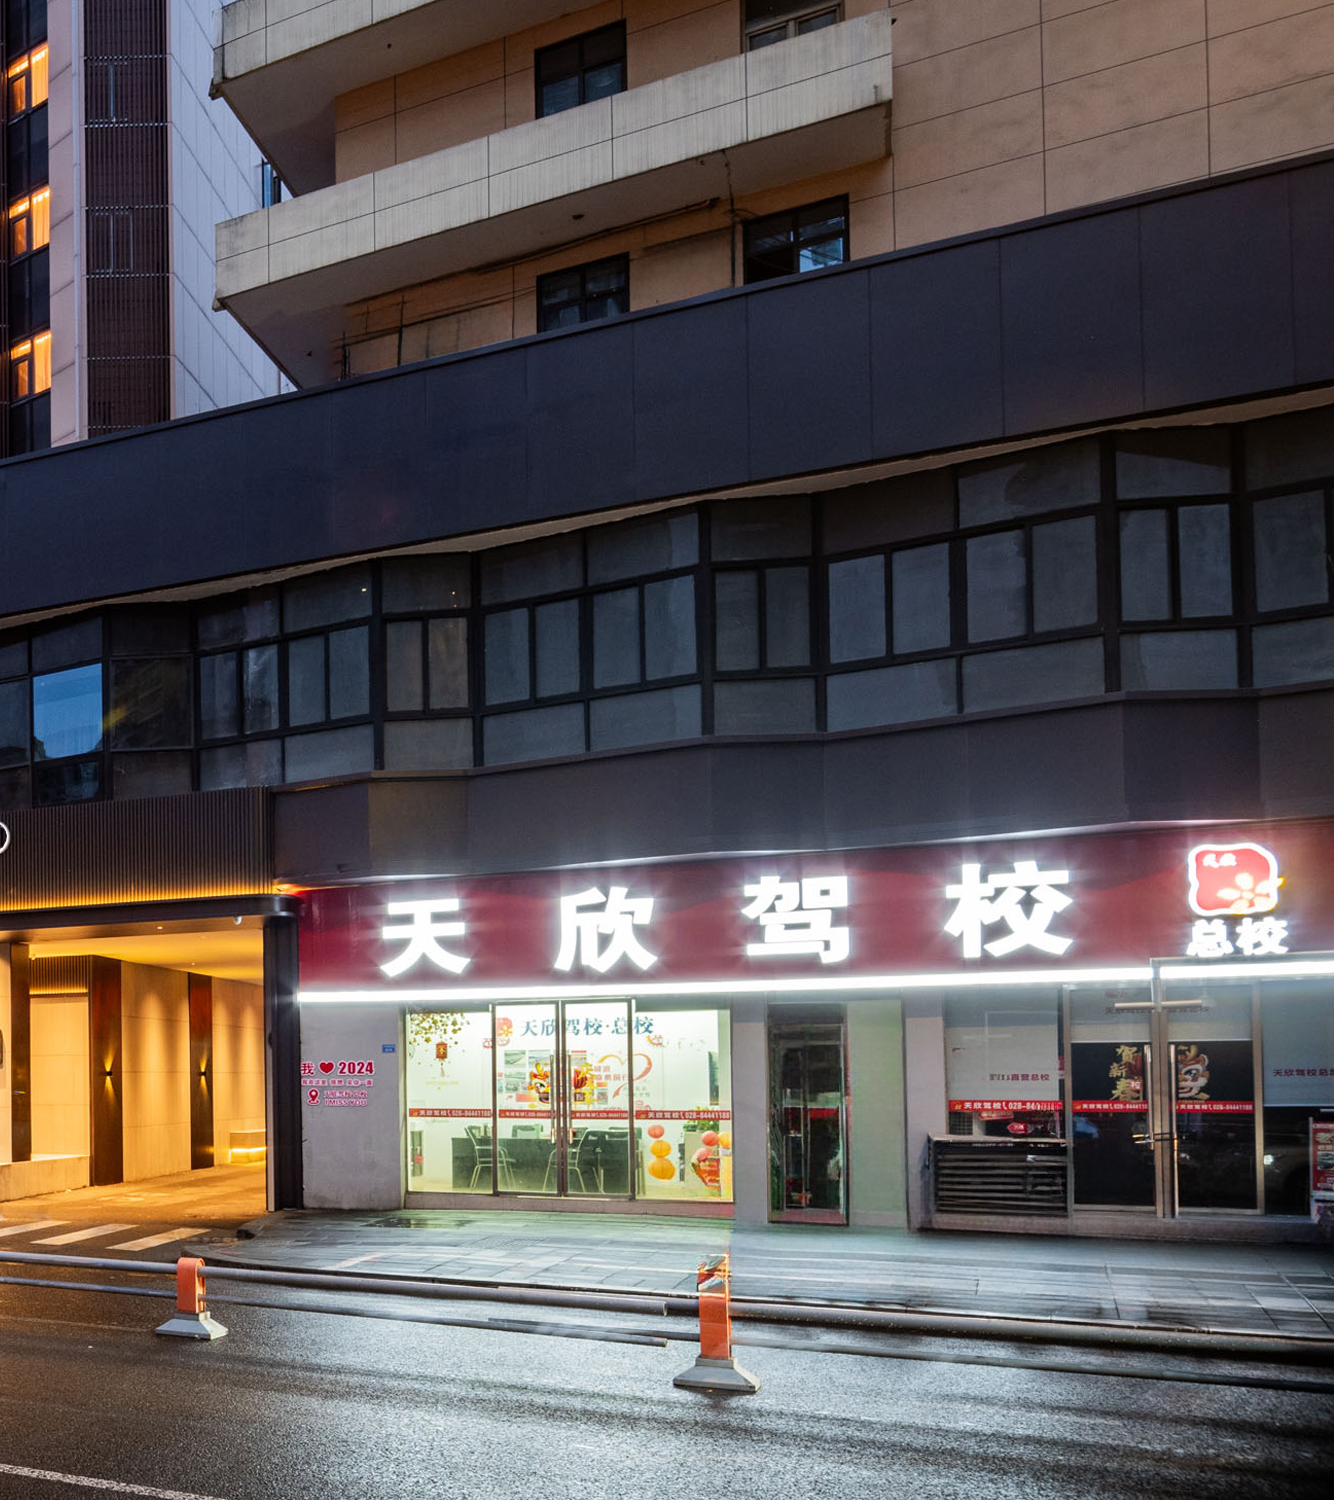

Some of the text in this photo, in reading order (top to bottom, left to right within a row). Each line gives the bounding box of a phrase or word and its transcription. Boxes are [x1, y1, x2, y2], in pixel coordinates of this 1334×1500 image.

[379, 860, 1074, 977] 天欣驾校
[1186, 917, 1289, 957] 总校
[301, 1061, 374, 1075] 我 2024
